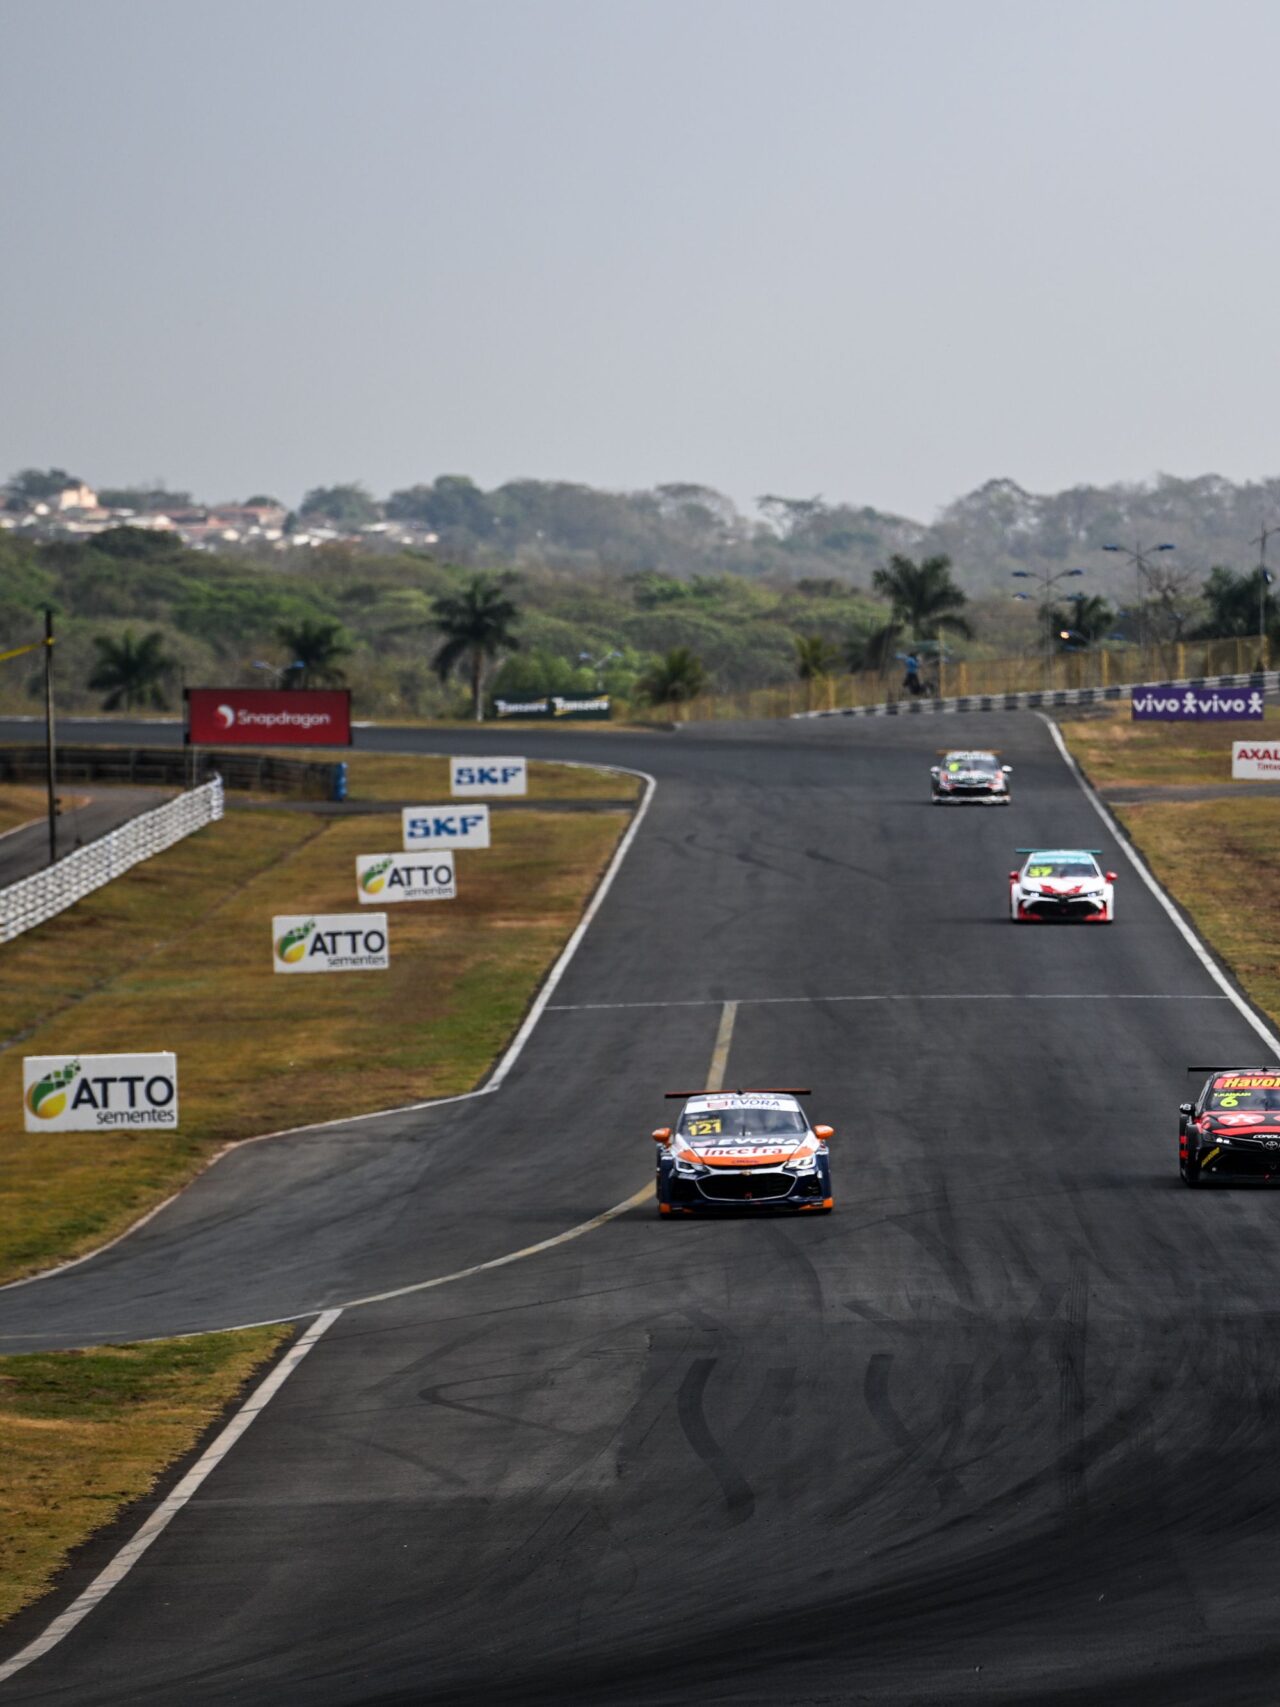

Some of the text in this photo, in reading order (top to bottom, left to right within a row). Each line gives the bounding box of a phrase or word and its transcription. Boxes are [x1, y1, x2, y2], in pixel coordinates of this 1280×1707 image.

[1132, 694, 1246, 713] vivo vivo
[237, 709, 330, 729] Snapdragon
[455, 767, 522, 786] SKF
[407, 814, 484, 838] SKF
[387, 865, 452, 888] ATTO
[309, 931, 385, 956] ATTO
[328, 956, 385, 967] sementes
[72, 1076, 174, 1109] ATTO
[1220, 1096, 1238, 1107] 6
[97, 1108, 174, 1124] sementes
[688, 1123, 721, 1136] 121
[718, 1138, 800, 1146] EVORA
